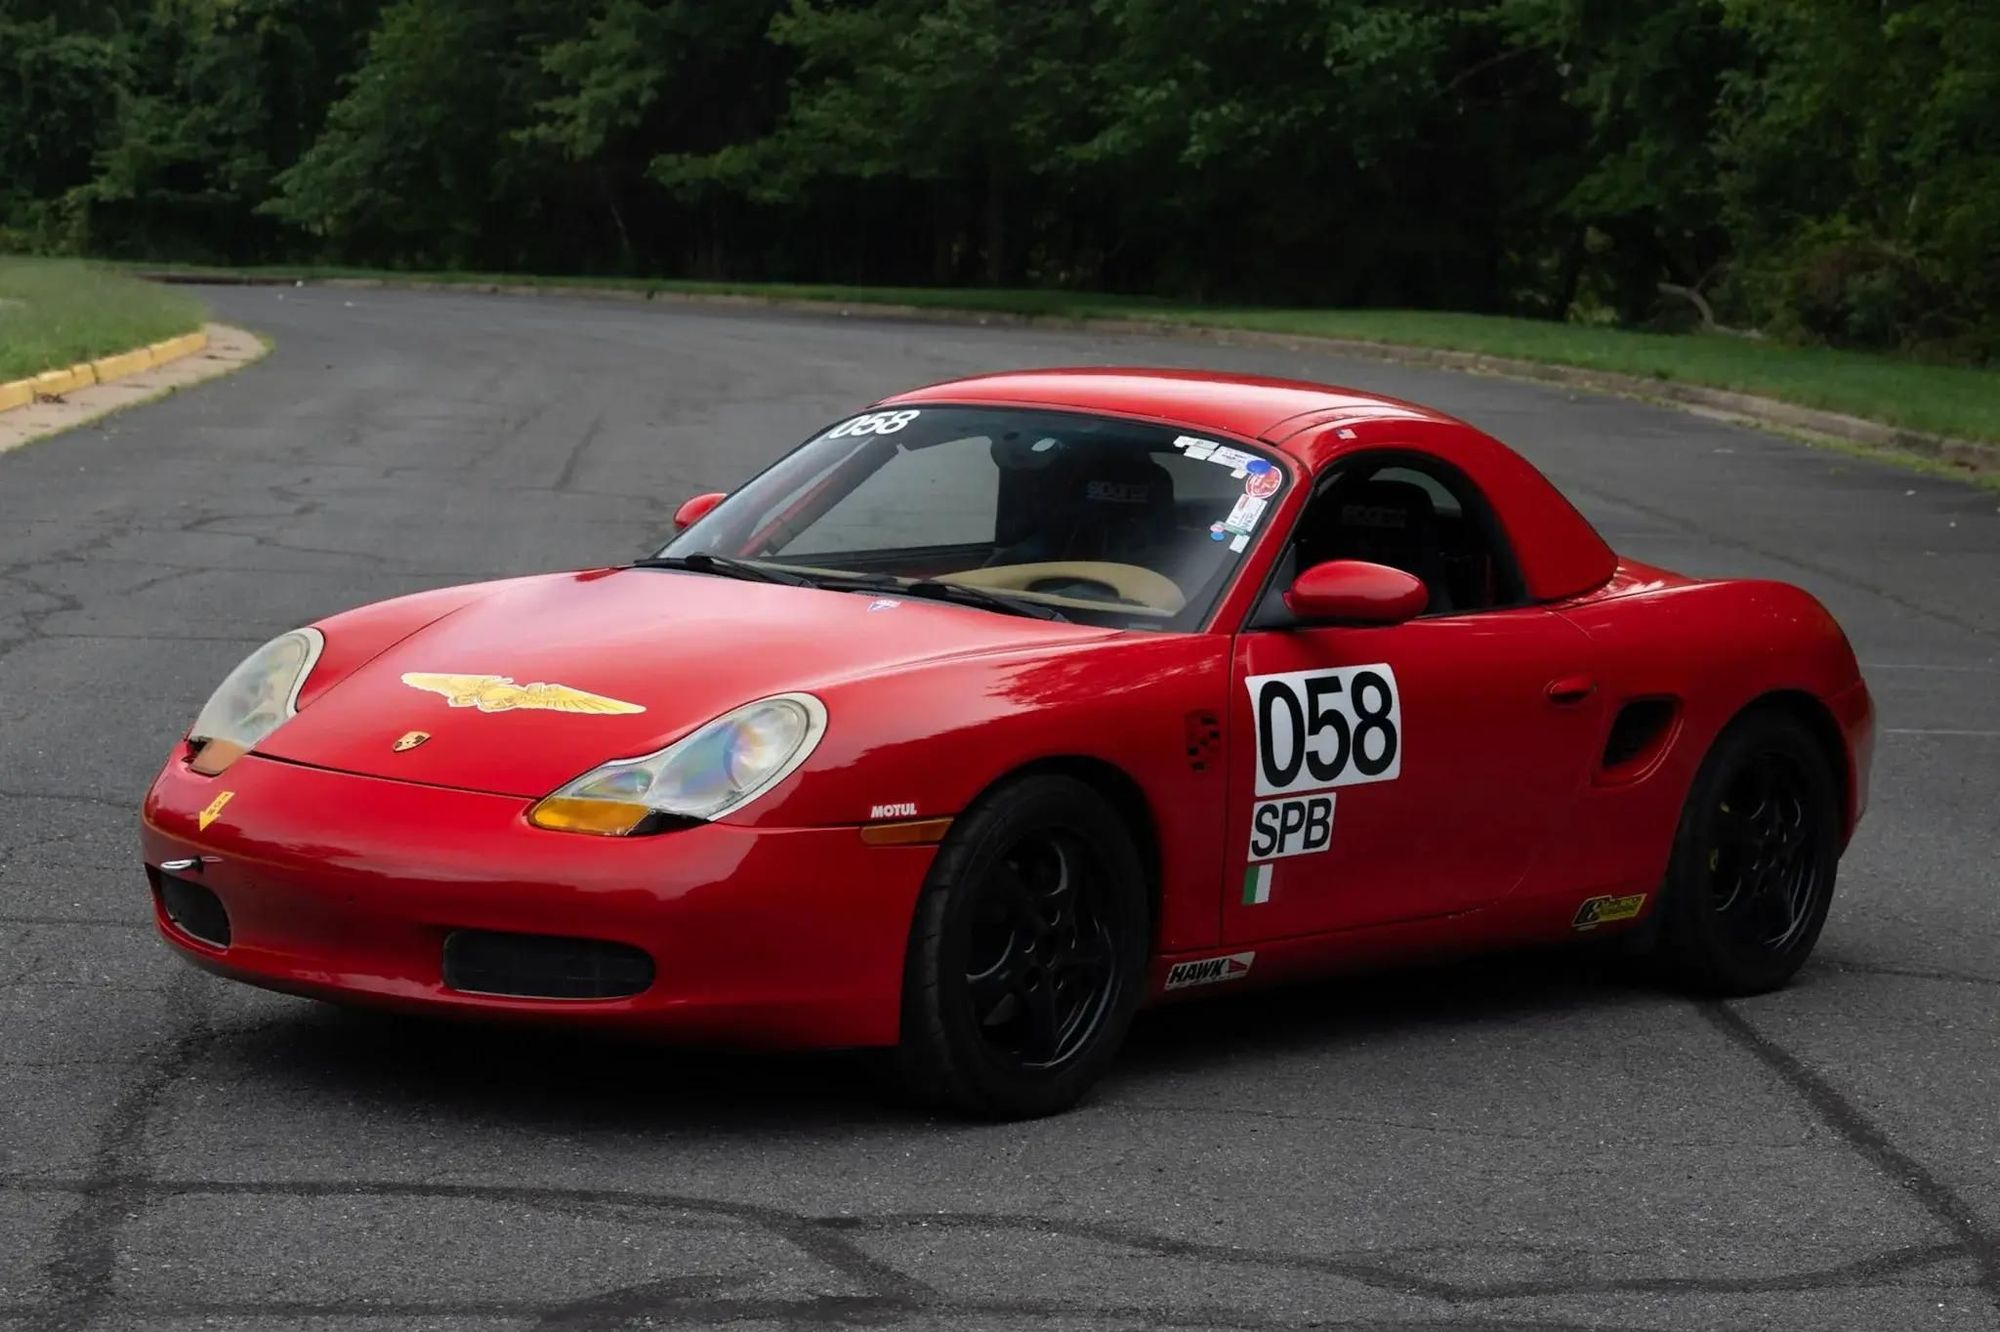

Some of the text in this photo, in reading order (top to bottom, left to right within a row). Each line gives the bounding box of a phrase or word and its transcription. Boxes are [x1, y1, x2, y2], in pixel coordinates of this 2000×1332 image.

[828, 409, 920, 438] 058
[1259, 671, 1397, 788] 058
[870, 802, 918, 819] MOTUL
[1251, 798, 1332, 857] SPB
[1169, 959, 1228, 984] HAWK
